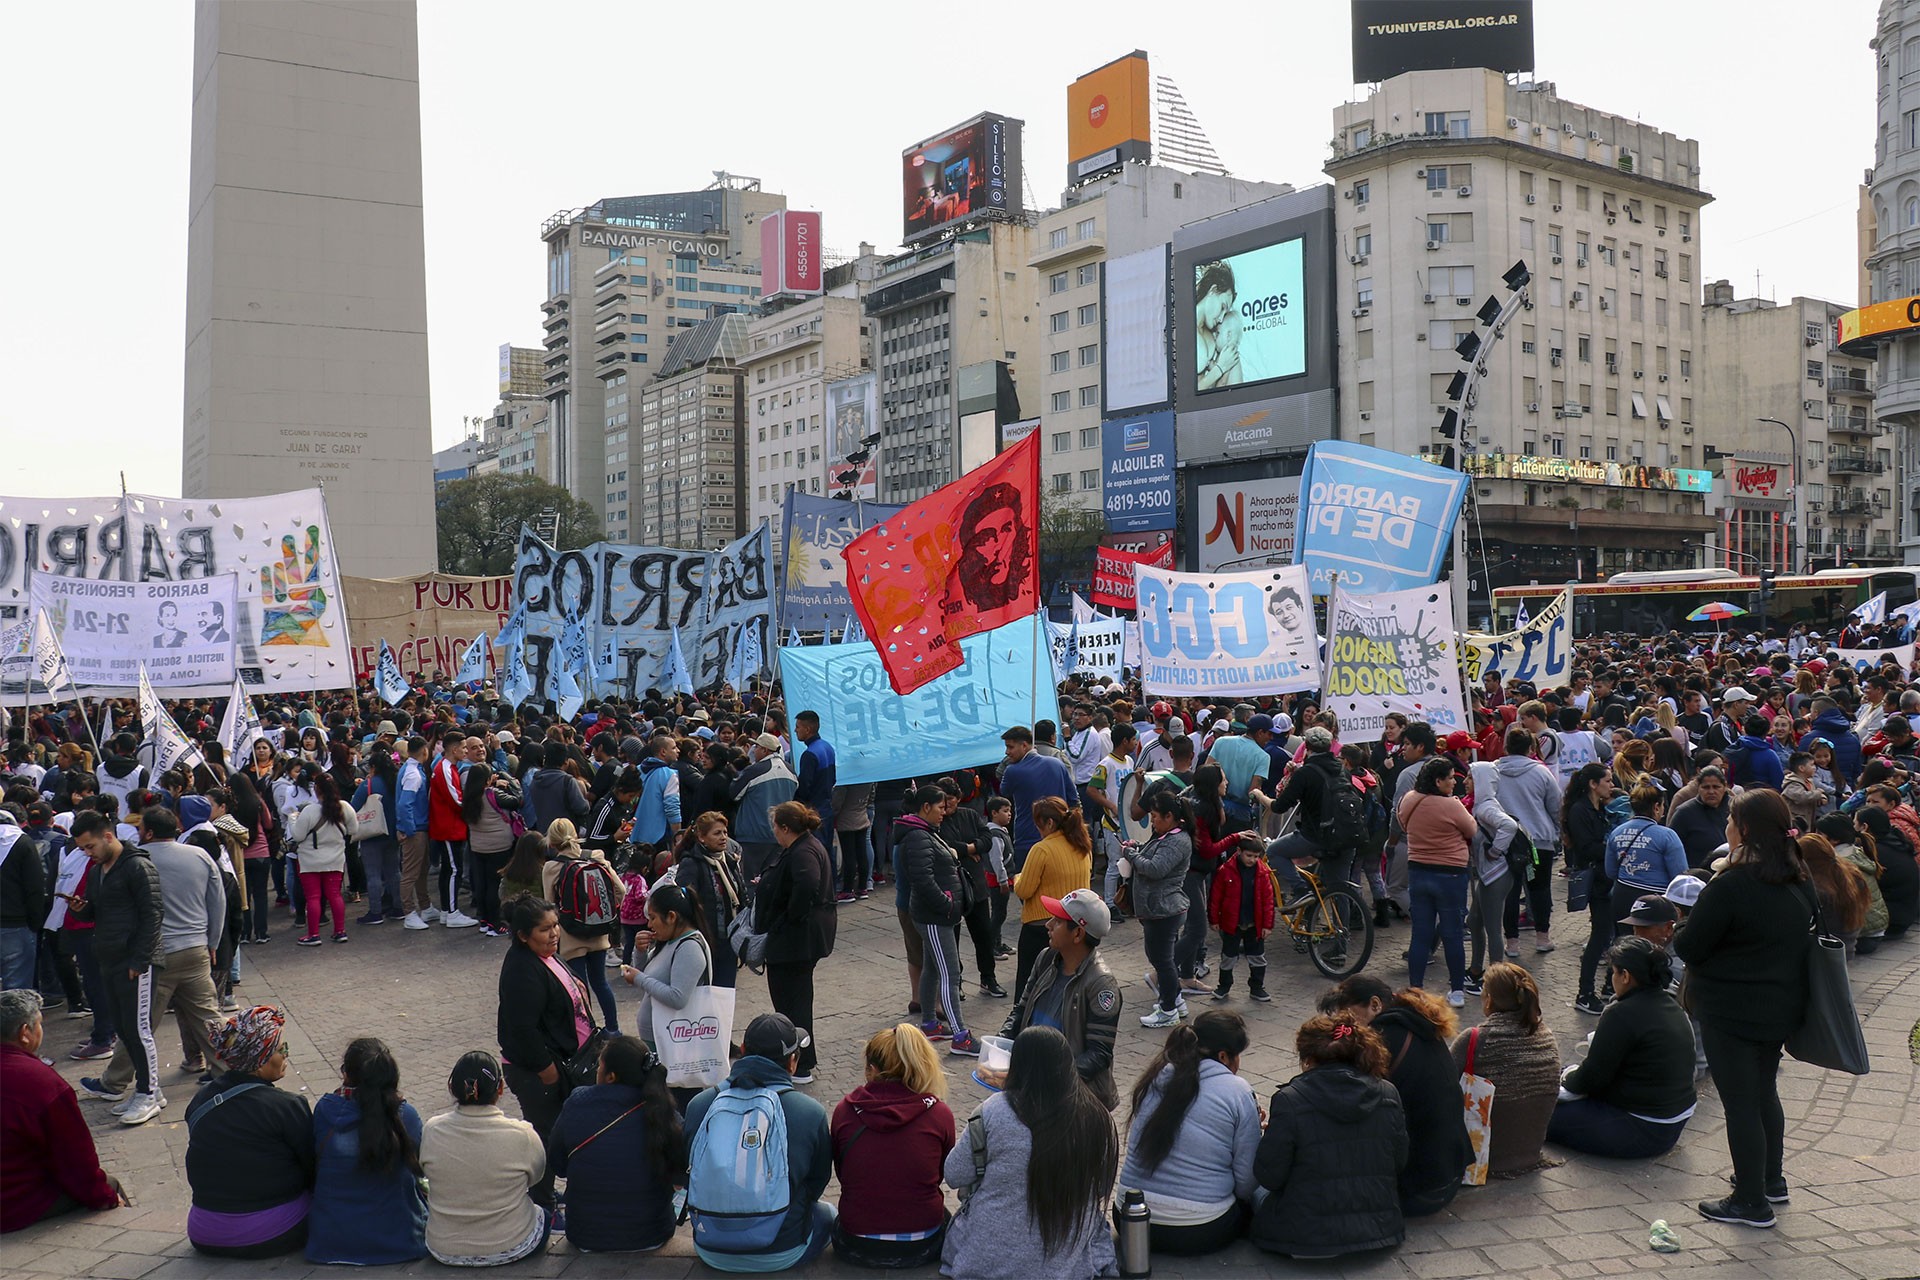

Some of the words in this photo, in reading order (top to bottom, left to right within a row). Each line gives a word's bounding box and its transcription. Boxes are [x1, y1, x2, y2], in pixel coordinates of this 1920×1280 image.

[1368, 14, 1518, 36] TVUNIVERSAL.ORG.AR
[992, 123, 1002, 176] SILEO
[581, 230, 720, 257] PANAMEICANO
[797, 222, 808, 280] 4556-1701
[1241, 292, 1289, 321] apres
[1256, 316, 1288, 332] GLOBAL
[280, 429, 310, 437] SEGUNDA
[313, 430, 351, 438] FUNDACION
[1127, 427, 1147, 438] Colliers
[1224, 426, 1273, 444] Atacama
[286, 443, 310, 453] JUAN
[315, 443, 327, 454] DE
[332, 444, 362, 455] GARAY
[1111, 454, 1165, 474] ALQUILER
[1568, 462, 1605, 480] cultura
[1106, 480, 1113, 488] de
[1113, 477, 1132, 489] espacio
[1133, 475, 1148, 485] aéreo
[1149, 473, 1170, 485] superior
[1106, 489, 1171, 512] 4819-9500
[1250, 496, 1273, 507] Ahora
[1275, 494, 1299, 506] podés
[1250, 508, 1277, 519] porque
[1279, 504, 1295, 516] hay
[1250, 519, 1275, 531] mucho
[1277, 518, 1294, 530] más
[1696, 582, 1730, 590] AUTOPISTA
[1775, 580, 1808, 588] AAVEDRA
[1823, 577, 1847, 585] LOPEZ
[415, 580, 475, 611] POR
[140, 988, 149, 1010] LOOK
[140, 1011, 149, 1031] BACK
